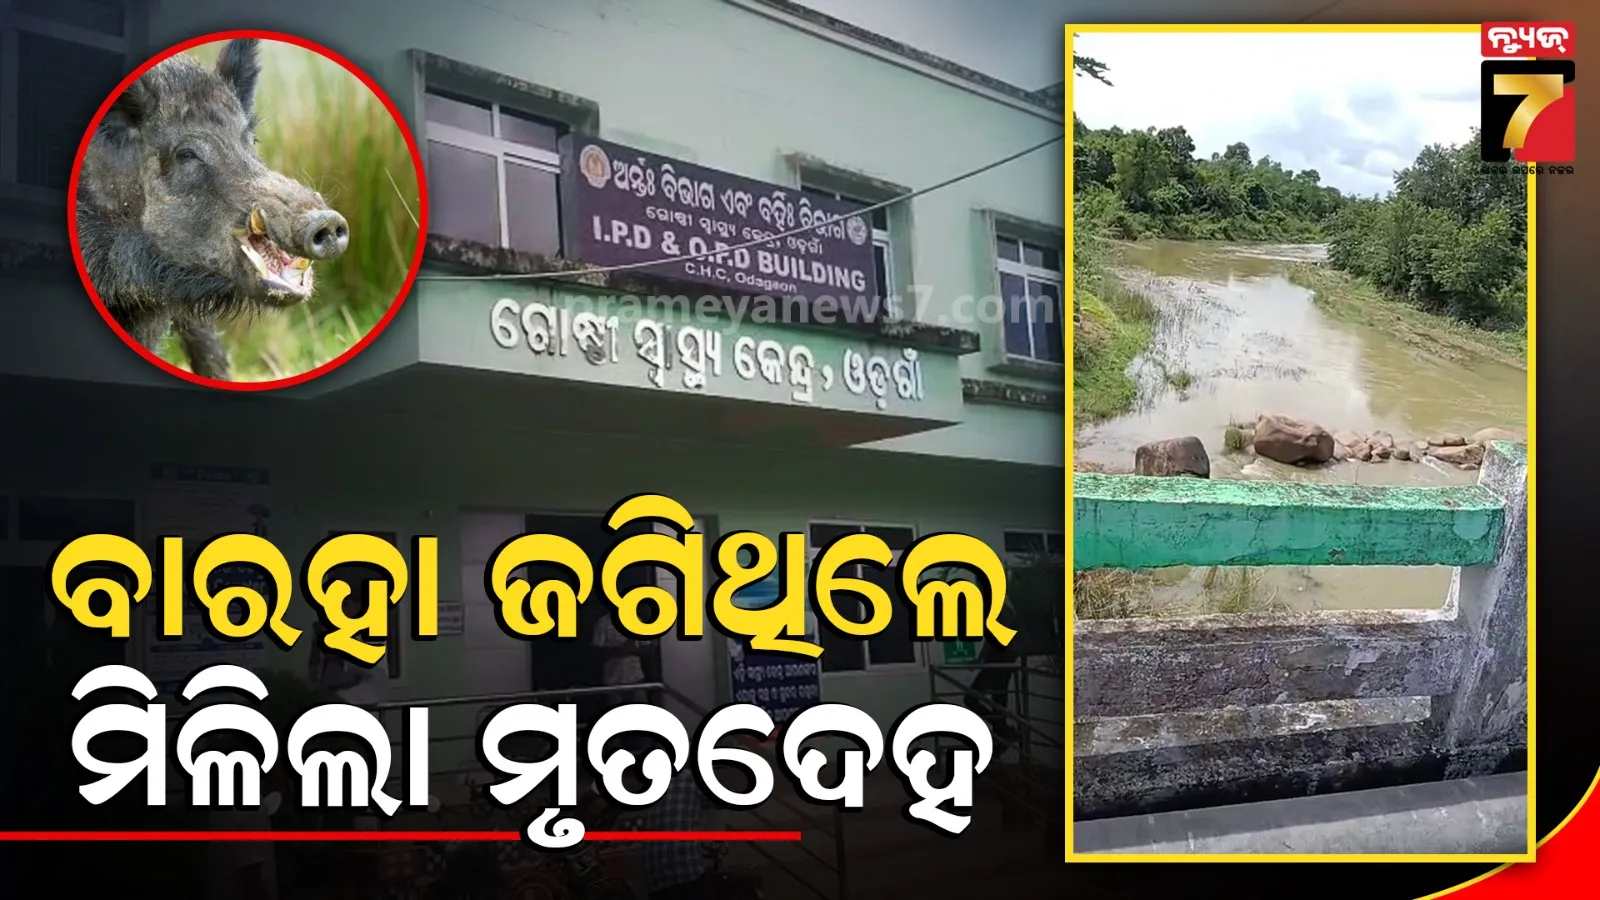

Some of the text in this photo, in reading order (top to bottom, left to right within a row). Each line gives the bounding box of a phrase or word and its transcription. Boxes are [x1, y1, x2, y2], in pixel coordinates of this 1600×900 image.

[661, 163, 715, 211] ବିଭାଗ
[720, 188, 753, 218] ଏବଂ
[592, 215, 866, 292] I.P.D & O.P.D BUILDING
[735, 271, 797, 293] Odagaon
